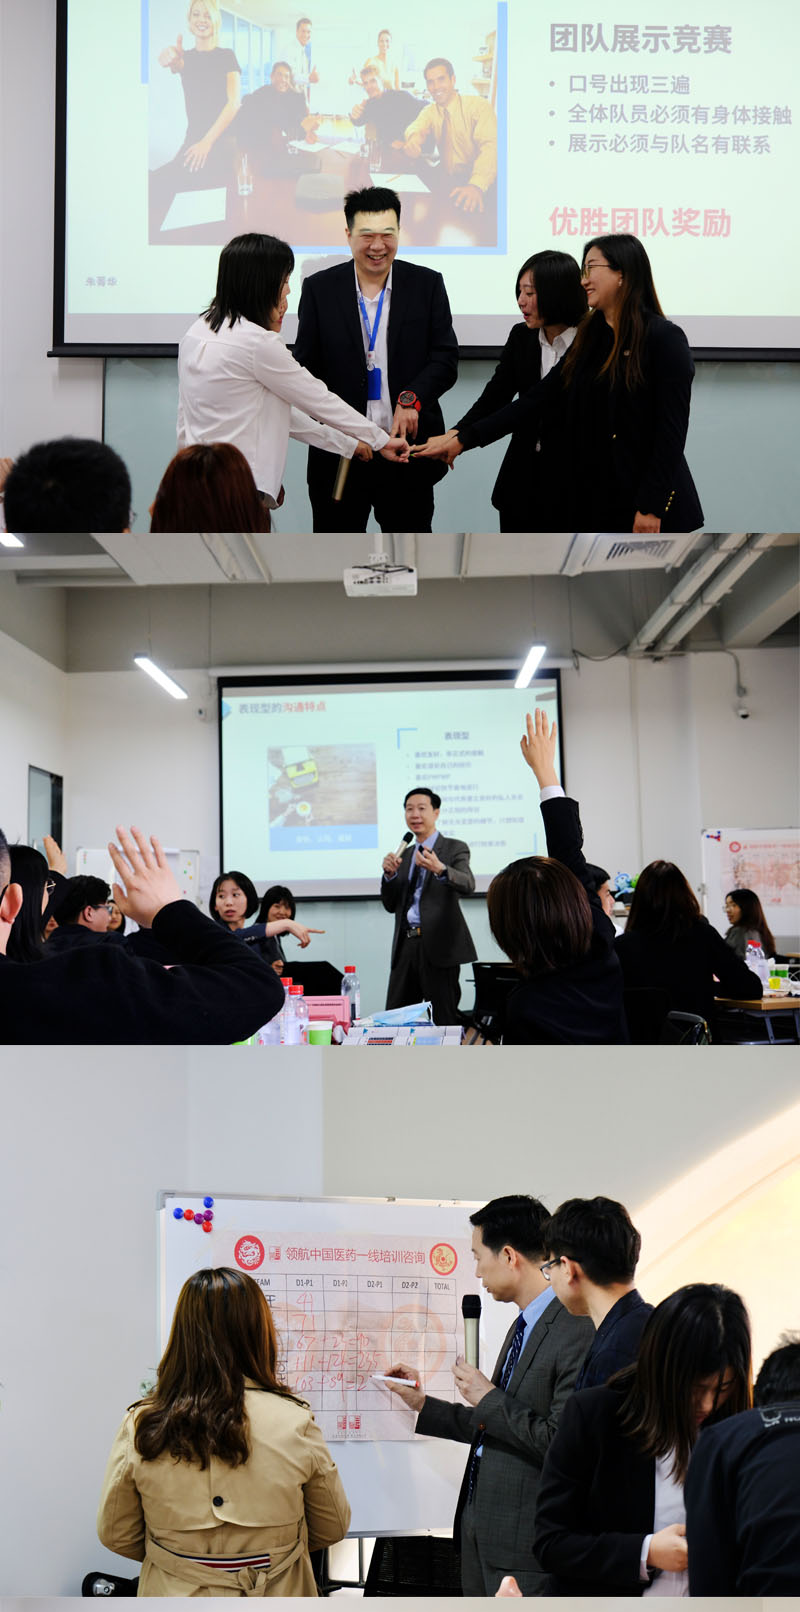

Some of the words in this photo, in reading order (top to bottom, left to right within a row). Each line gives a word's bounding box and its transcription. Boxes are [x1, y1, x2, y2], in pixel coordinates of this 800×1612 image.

[550, 23, 733, 54] 团队展示竞赛
[569, 73, 691, 95] 口号出现三遍
[568, 103, 793, 126] 全体队员必须有身体接触
[568, 133, 771, 155] 展示必须与队名有联系
[549, 206, 732, 238] 优胜团队奖励
[286, 1247, 425, 1264] 领航中国医药一线培训咨询
[296, 1279, 314, 1287] D1-P1
[367, 1280, 383, 1288] D2-P1
[402, 1281, 418, 1289] D2-P2
[434, 1282, 450, 1290] TOTAL
